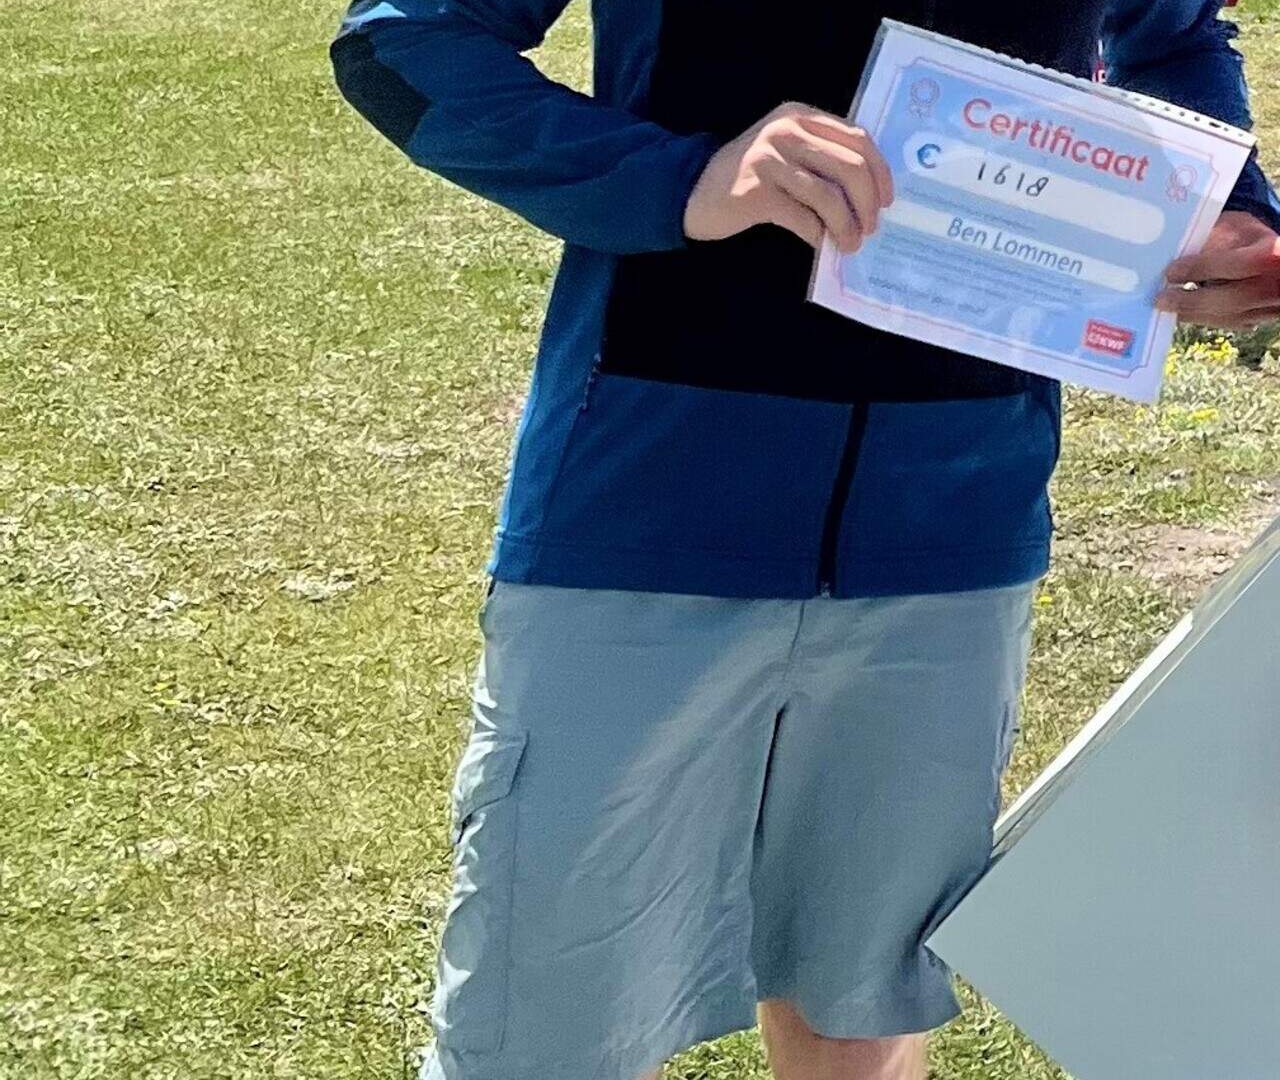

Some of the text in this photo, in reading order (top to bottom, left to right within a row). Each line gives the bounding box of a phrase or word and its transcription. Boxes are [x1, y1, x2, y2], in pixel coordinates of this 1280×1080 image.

[962, 97, 1150, 183] Certificaat
[976, 162, 1050, 198] 1618
[947, 216, 988, 246] Ben
[992, 231, 1084, 276] Lommen
